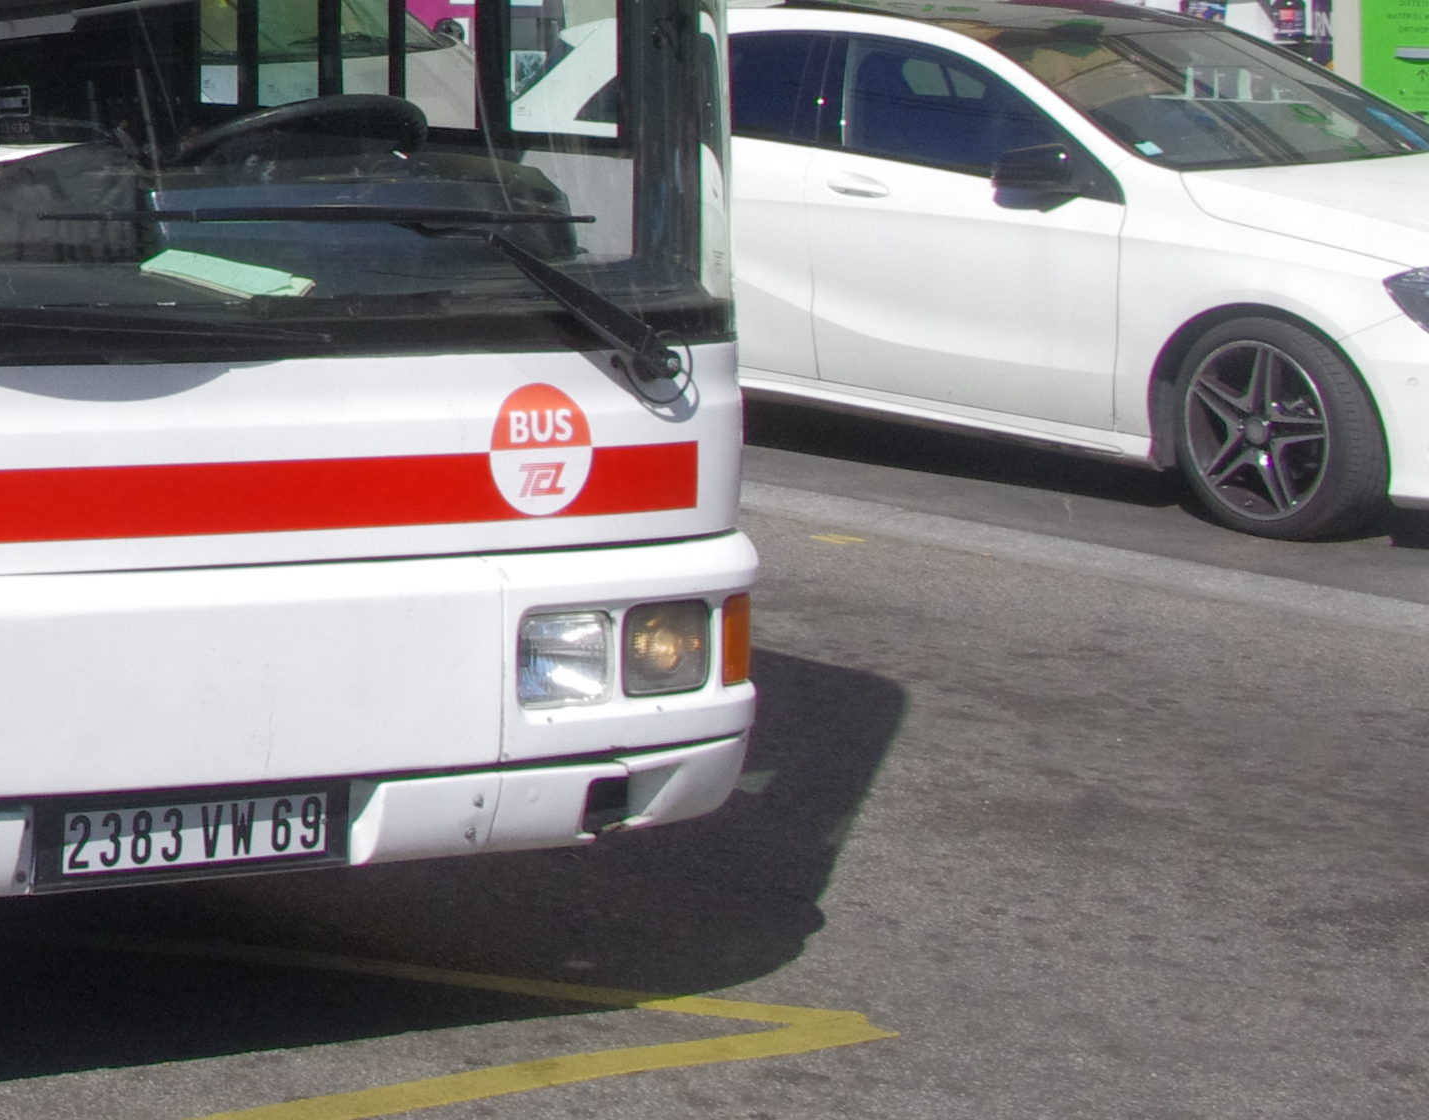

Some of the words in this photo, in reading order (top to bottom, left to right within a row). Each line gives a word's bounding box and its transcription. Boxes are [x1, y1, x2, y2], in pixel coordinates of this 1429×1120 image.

[508, 408, 574, 444] BUS
[67, 807, 183, 870] 2383
[201, 801, 255, 859] VW
[271, 795, 323, 852] 69
